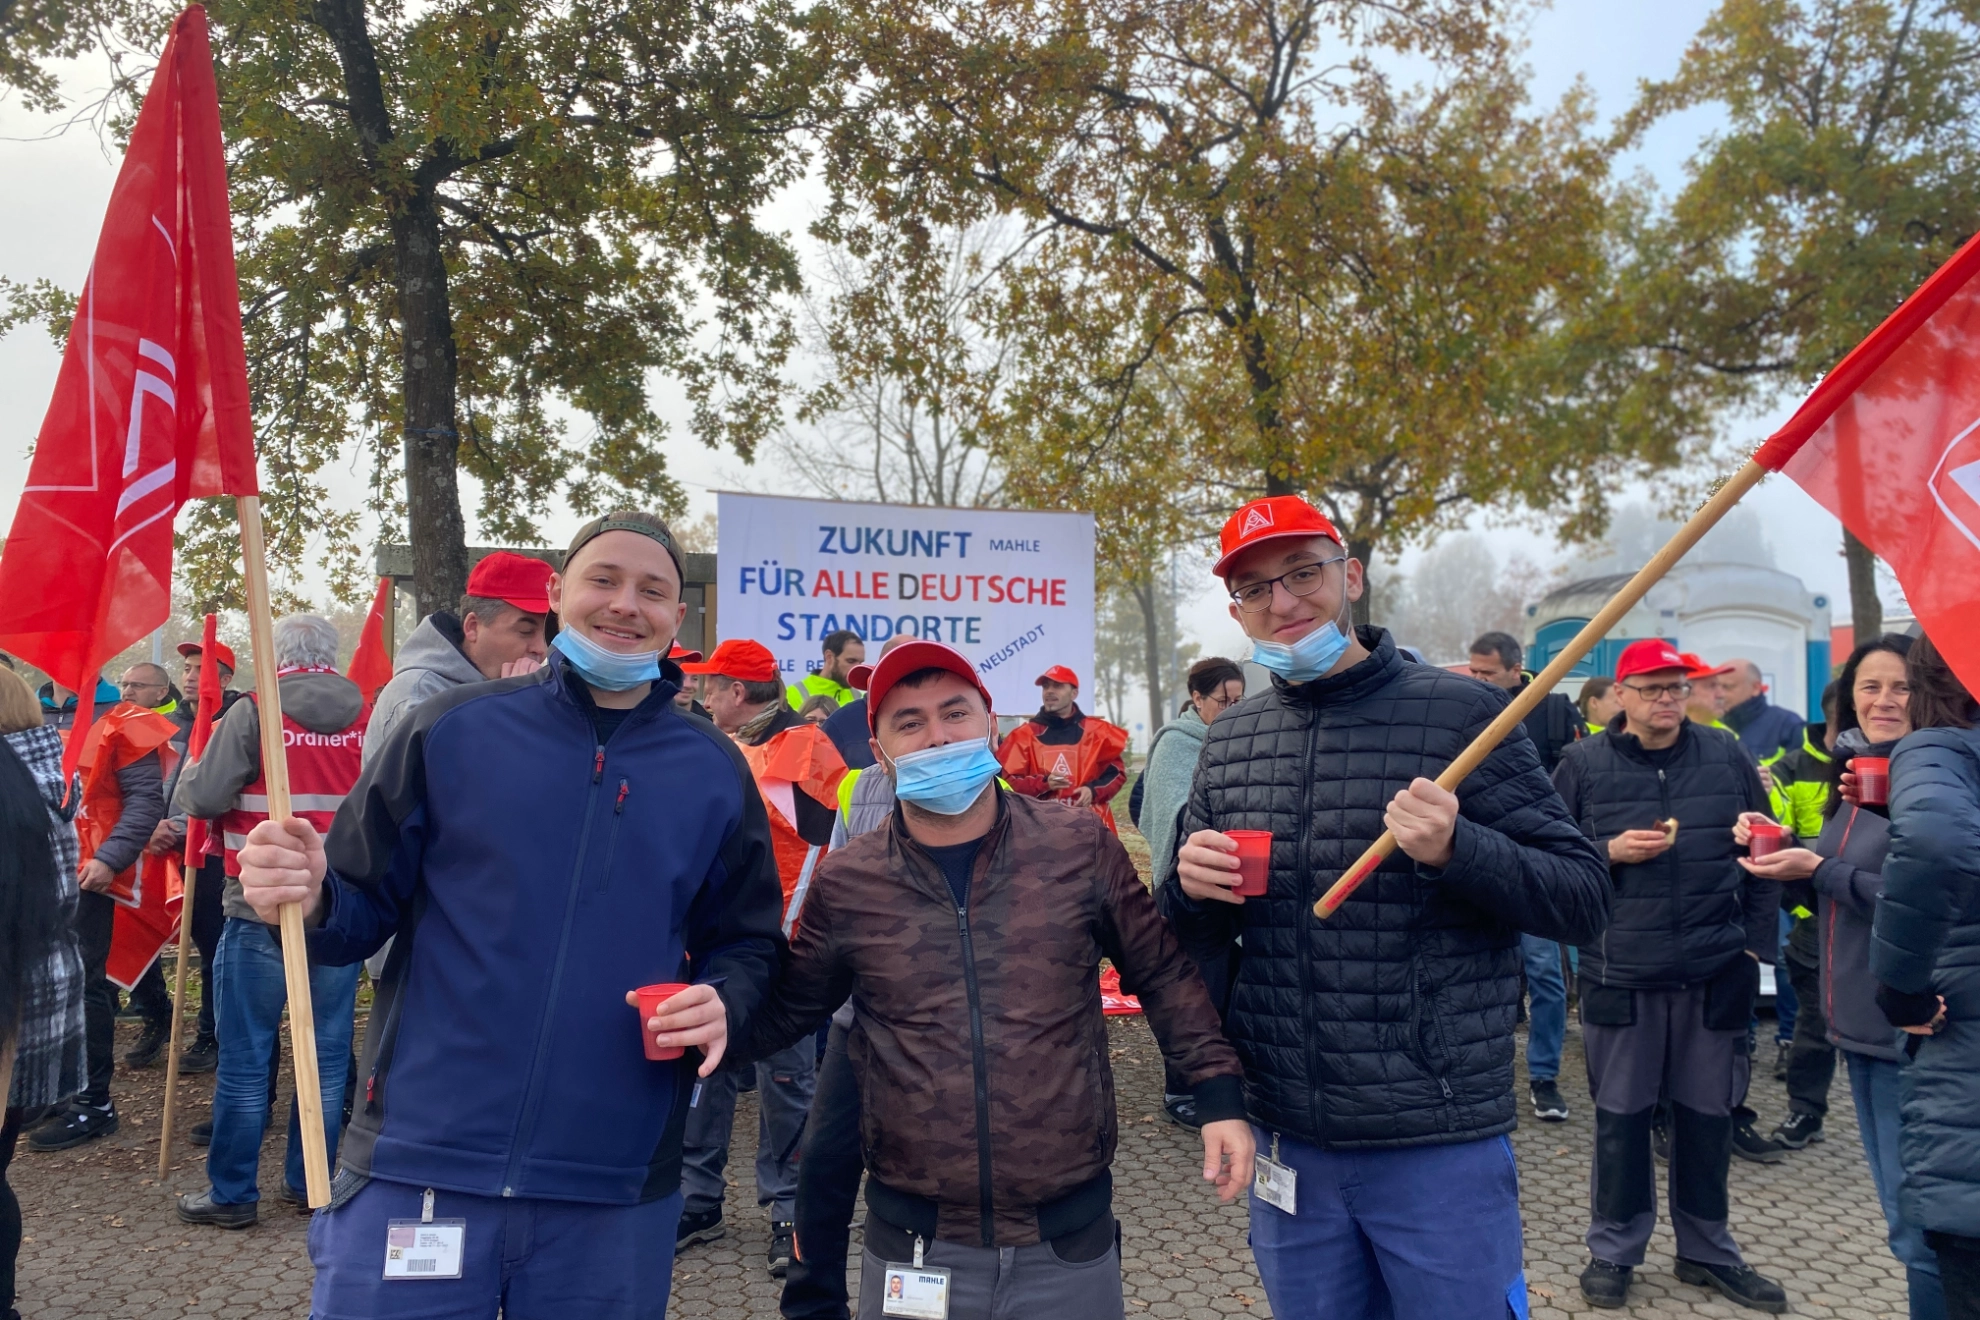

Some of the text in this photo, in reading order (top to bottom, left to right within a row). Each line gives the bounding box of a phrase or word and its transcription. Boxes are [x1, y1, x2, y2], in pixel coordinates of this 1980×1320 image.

[818, 526, 972, 558] ZUKUNFT
[989, 539, 1040, 552] MAHLE
[740, 559, 1067, 606] FÜR ALLE DEUTSCHE
[777, 611, 981, 643] STANDORTE
[776, 659, 795, 672] LE
[919, 1275, 944, 1285] MAHLE
